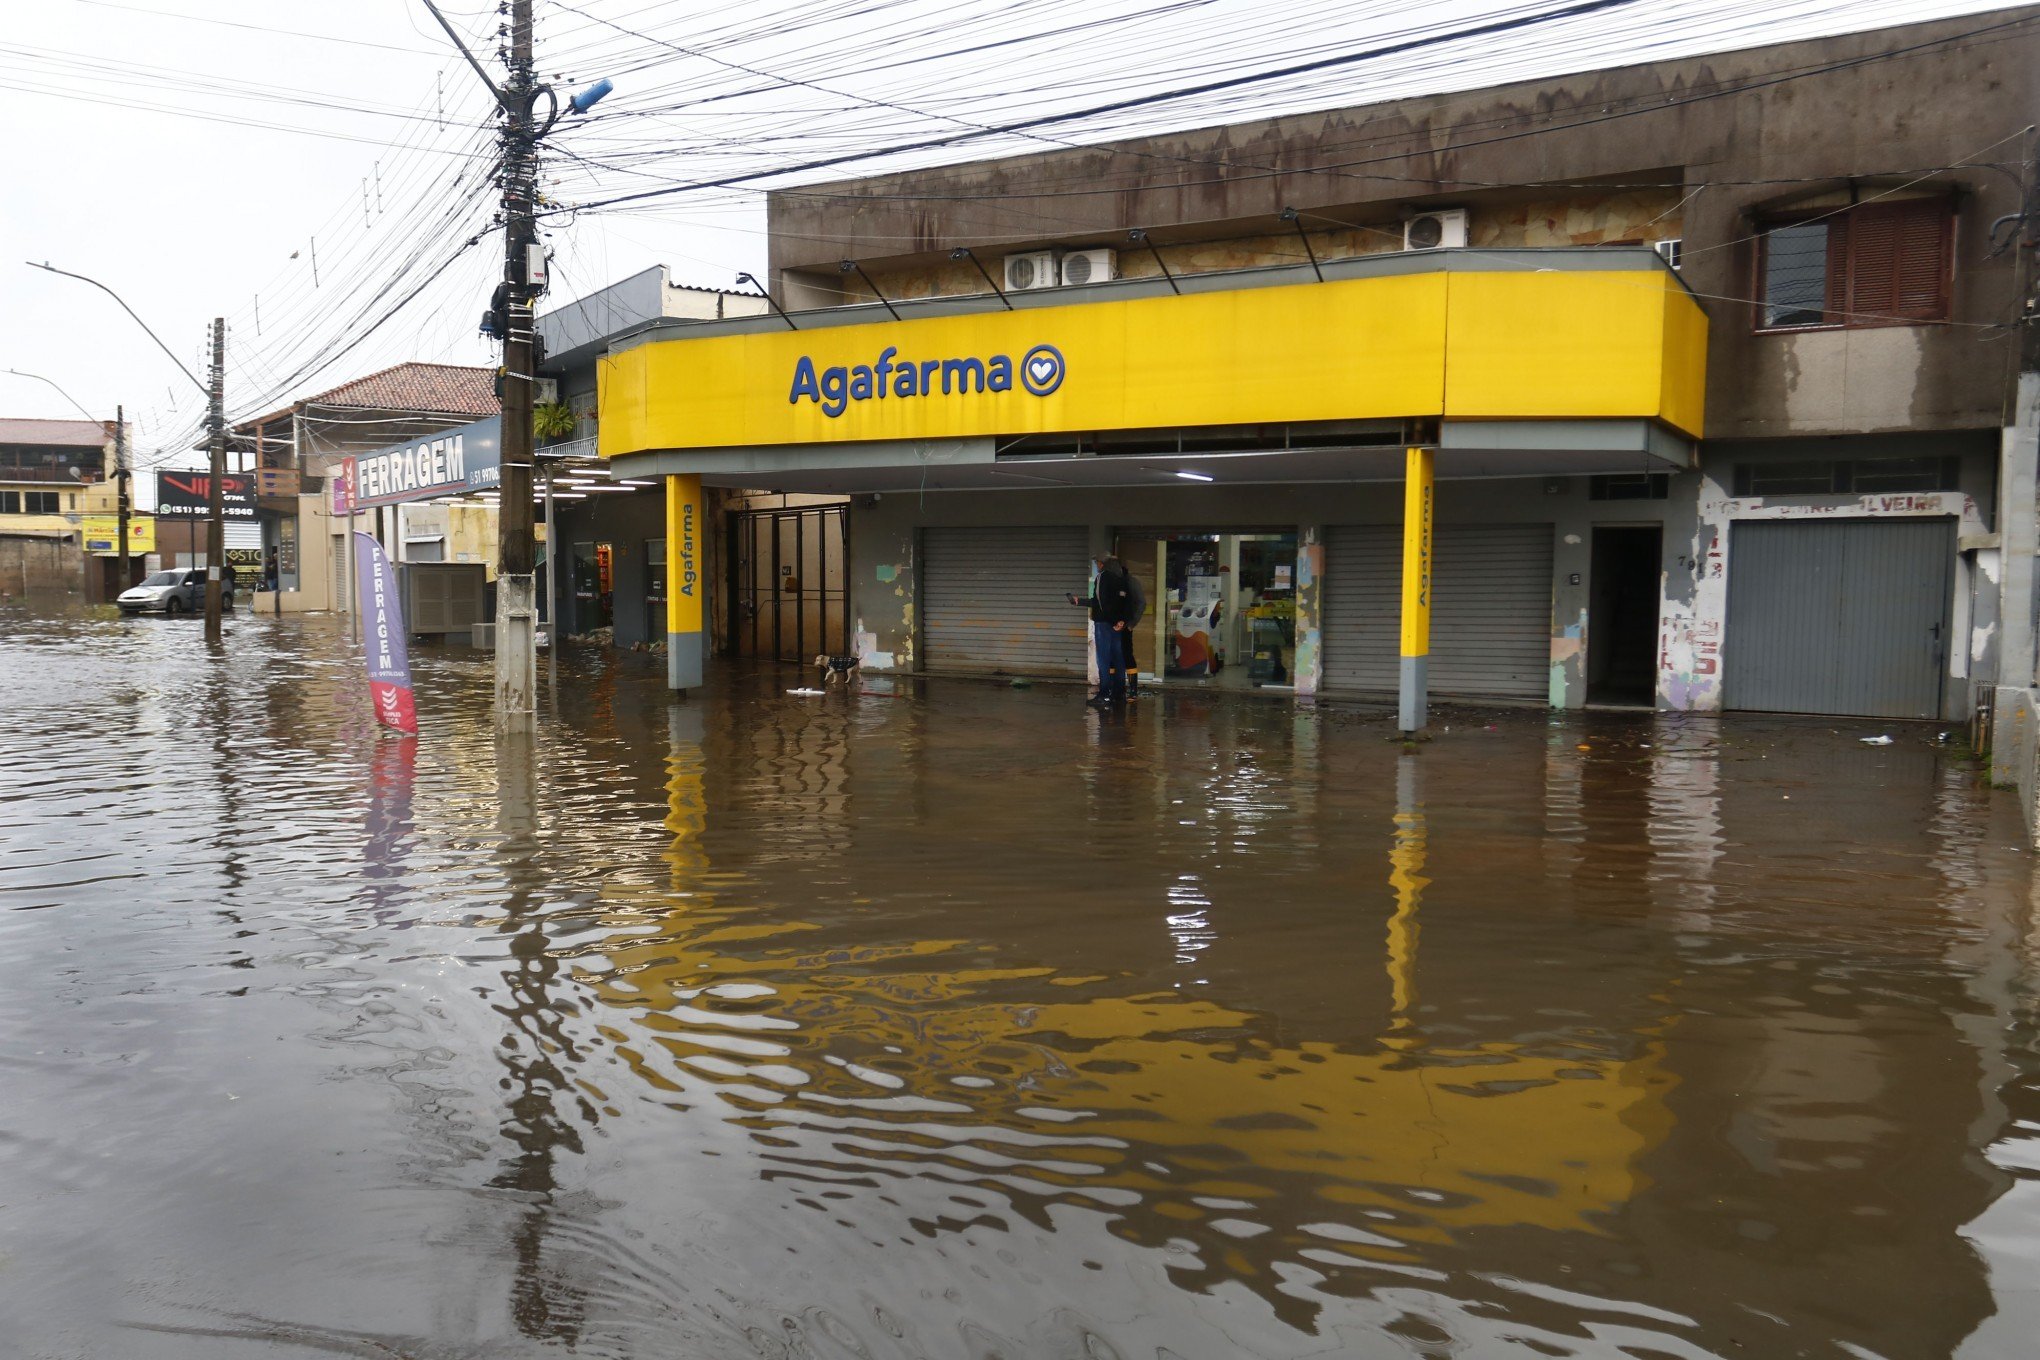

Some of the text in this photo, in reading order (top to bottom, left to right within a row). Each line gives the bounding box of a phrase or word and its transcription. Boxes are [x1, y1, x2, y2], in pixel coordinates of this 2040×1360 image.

[789, 346, 1012, 418] Agafarma
[358, 434, 465, 498] FERRAGEM
[172, 506, 192, 514] (51)
[681, 504, 696, 597] Agafarma
[372, 547, 392, 669] FERRAGEM
